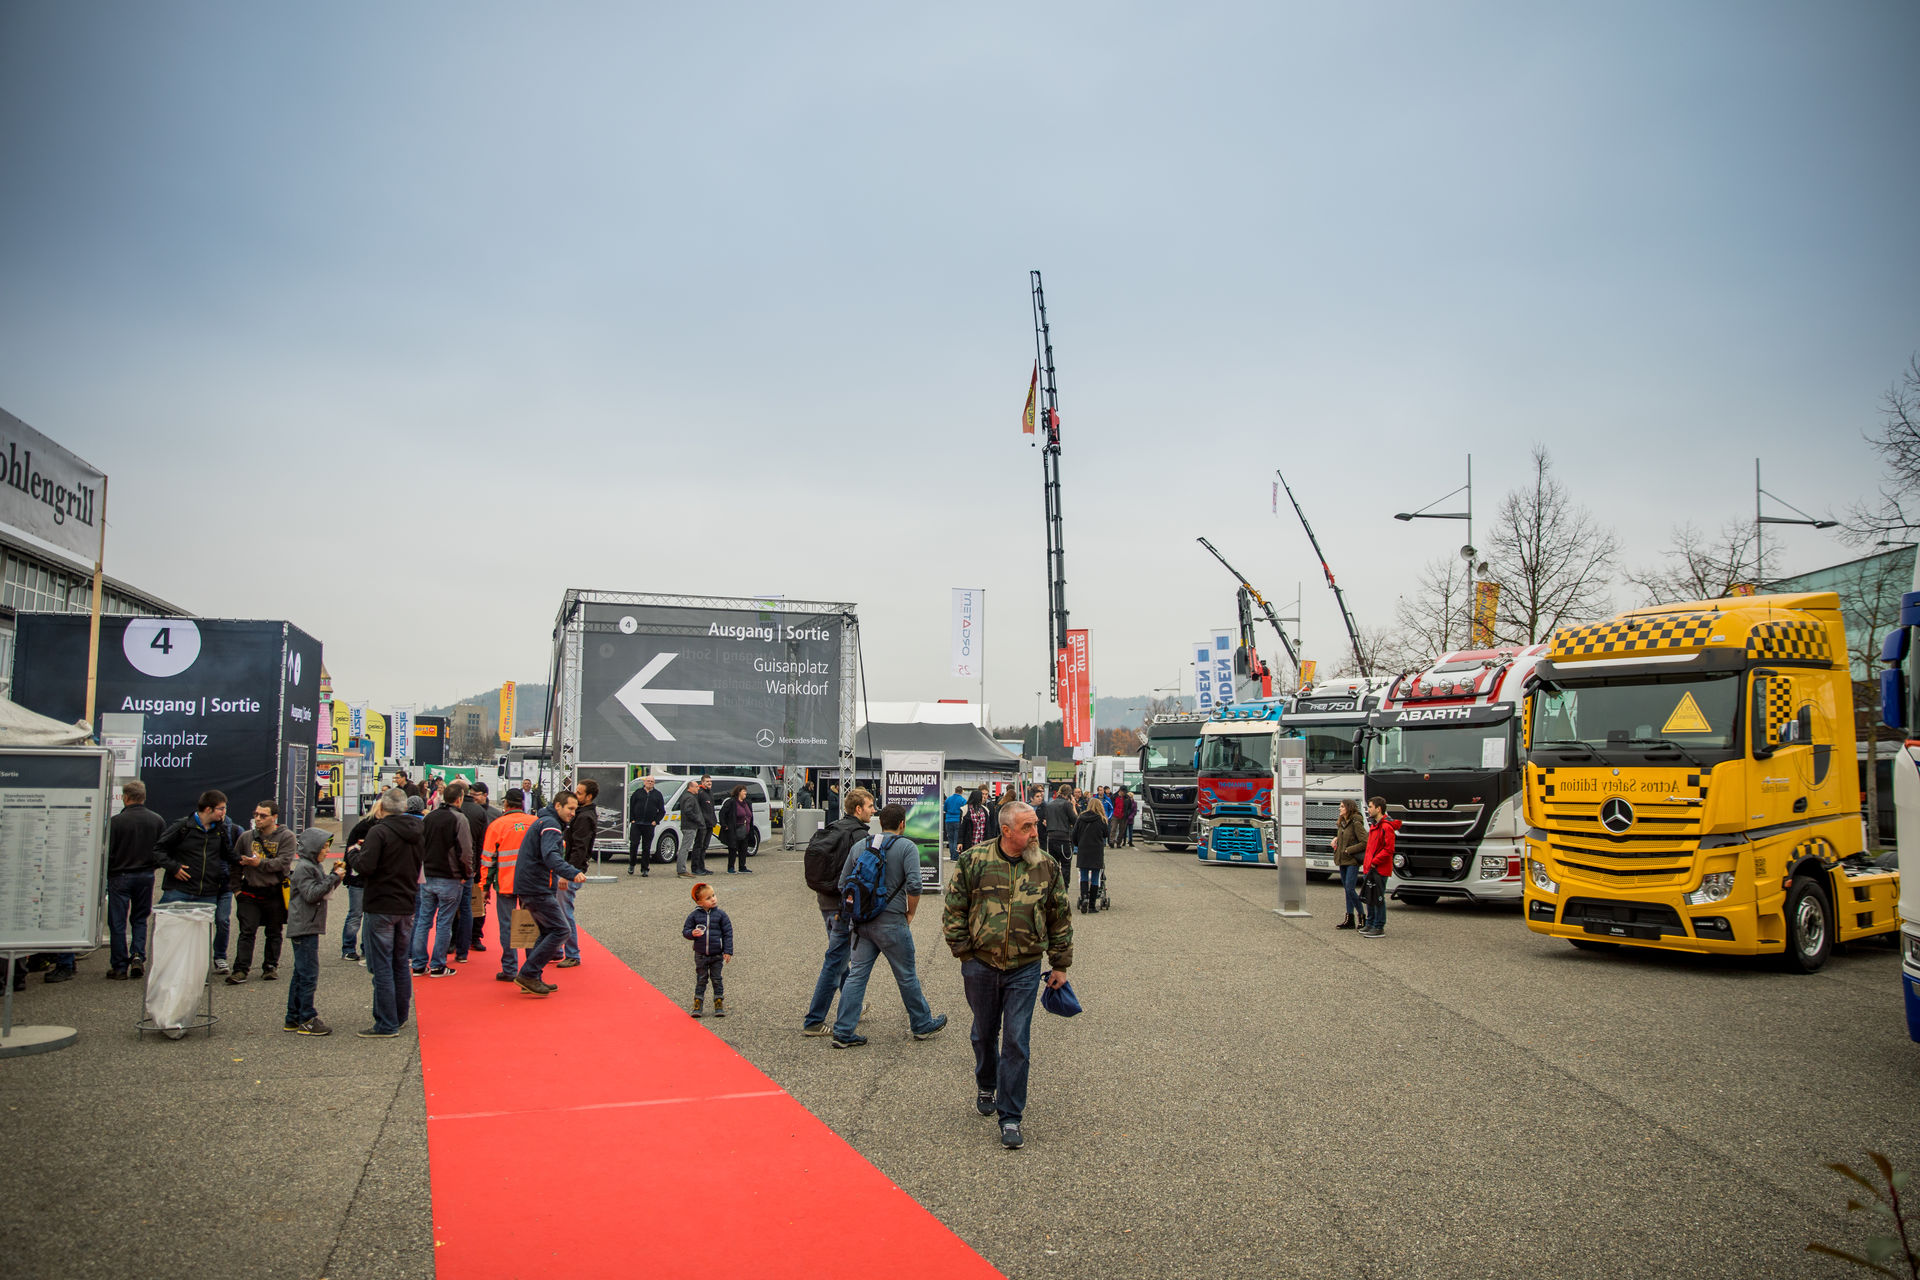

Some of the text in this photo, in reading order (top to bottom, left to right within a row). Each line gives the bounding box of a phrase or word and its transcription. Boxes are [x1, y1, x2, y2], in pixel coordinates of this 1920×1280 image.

[708, 622, 773, 642] Ausgang
[786, 626, 830, 641] Sortie
[150, 627, 173, 654] 4
[754, 658, 829, 676] Guisanplatz
[766, 680, 829, 695] Wankdorf
[121, 696, 196, 715] Ausgang
[211, 698, 260, 713] Sortie
[1328, 702, 1355, 710] 750
[1396, 708, 1471, 721] ABARTH
[142, 730, 208, 749] isanplatz
[779, 736, 828, 745] Mercedes-Benz
[140, 753, 193, 768] nkdorf
[888, 772, 937, 785] VÄLKOMMEN
[888, 786, 924, 794] BIENVENUE
[1408, 799, 1448, 808] IVECO
